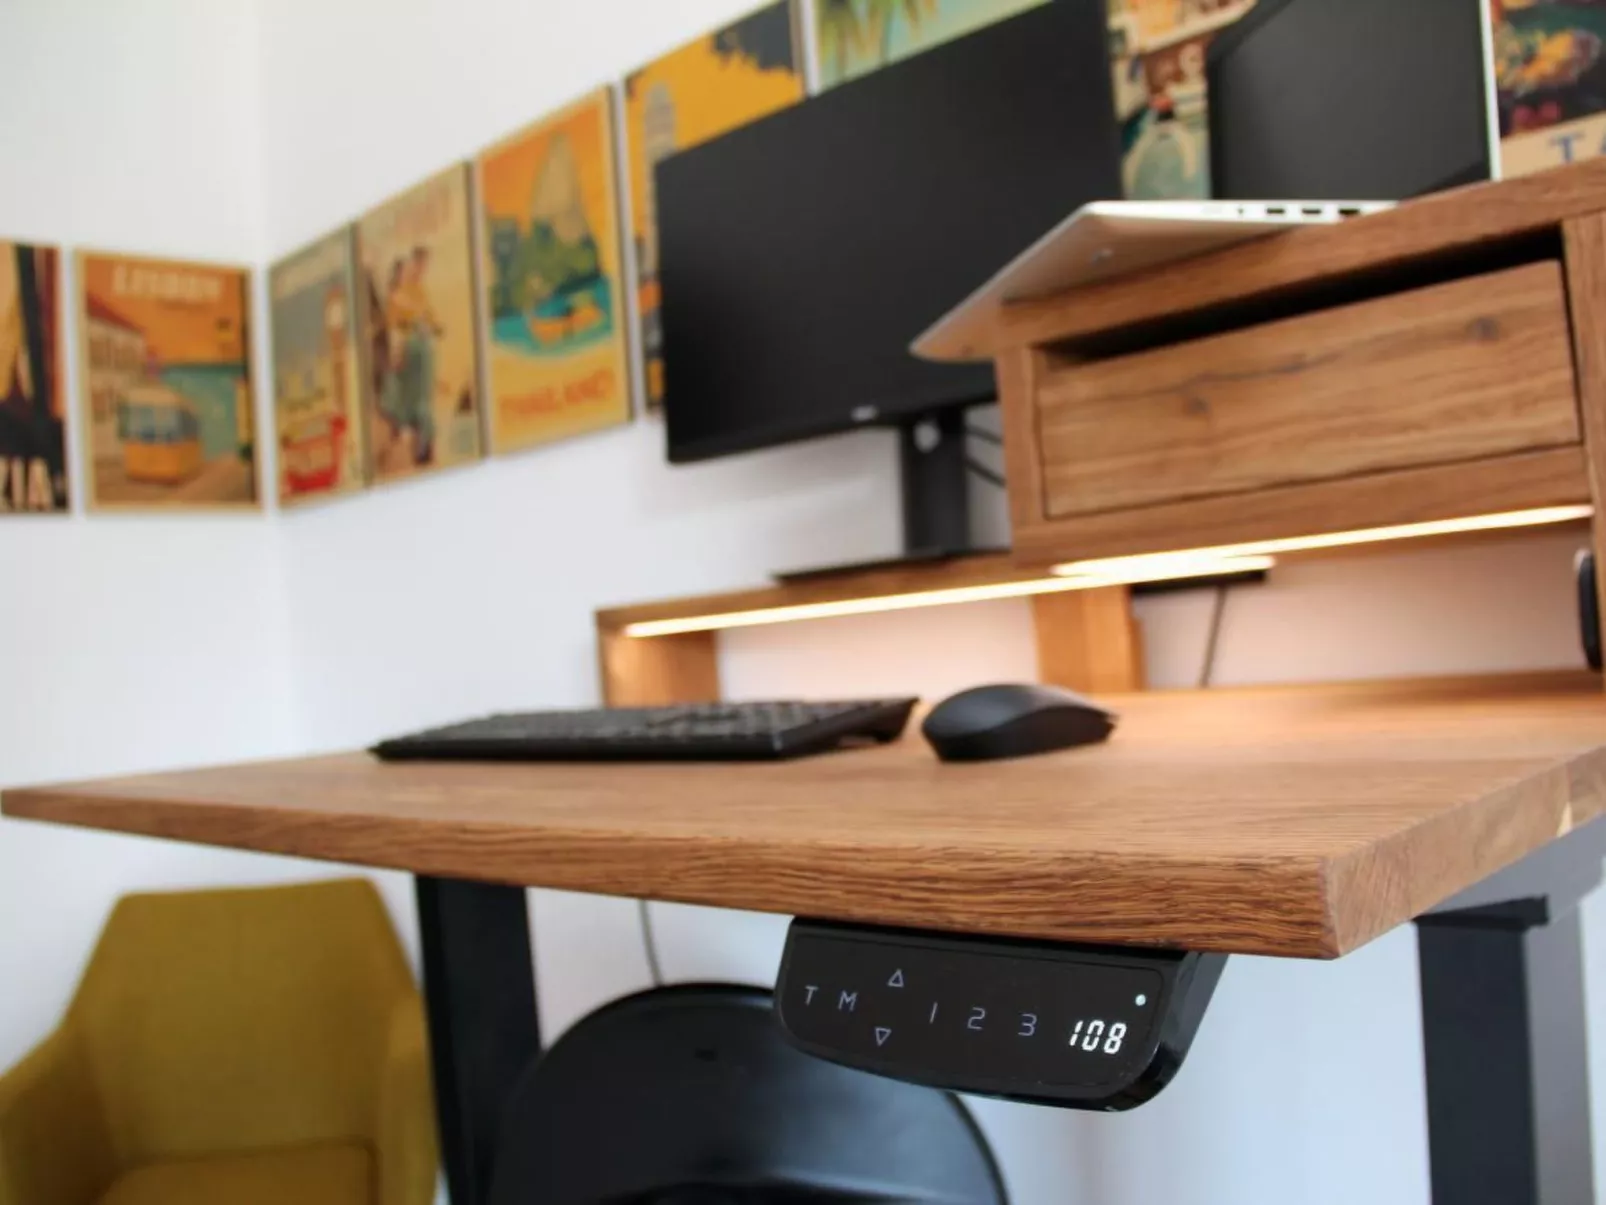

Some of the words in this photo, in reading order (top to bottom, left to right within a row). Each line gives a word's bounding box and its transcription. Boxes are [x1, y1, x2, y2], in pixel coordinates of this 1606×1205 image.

[804, 985, 819, 1006] T
[838, 991, 858, 1012] M
[967, 1007, 986, 1031] 2
[1018, 1013, 1038, 1037] 3
[1069, 1019, 1128, 1055] 108
